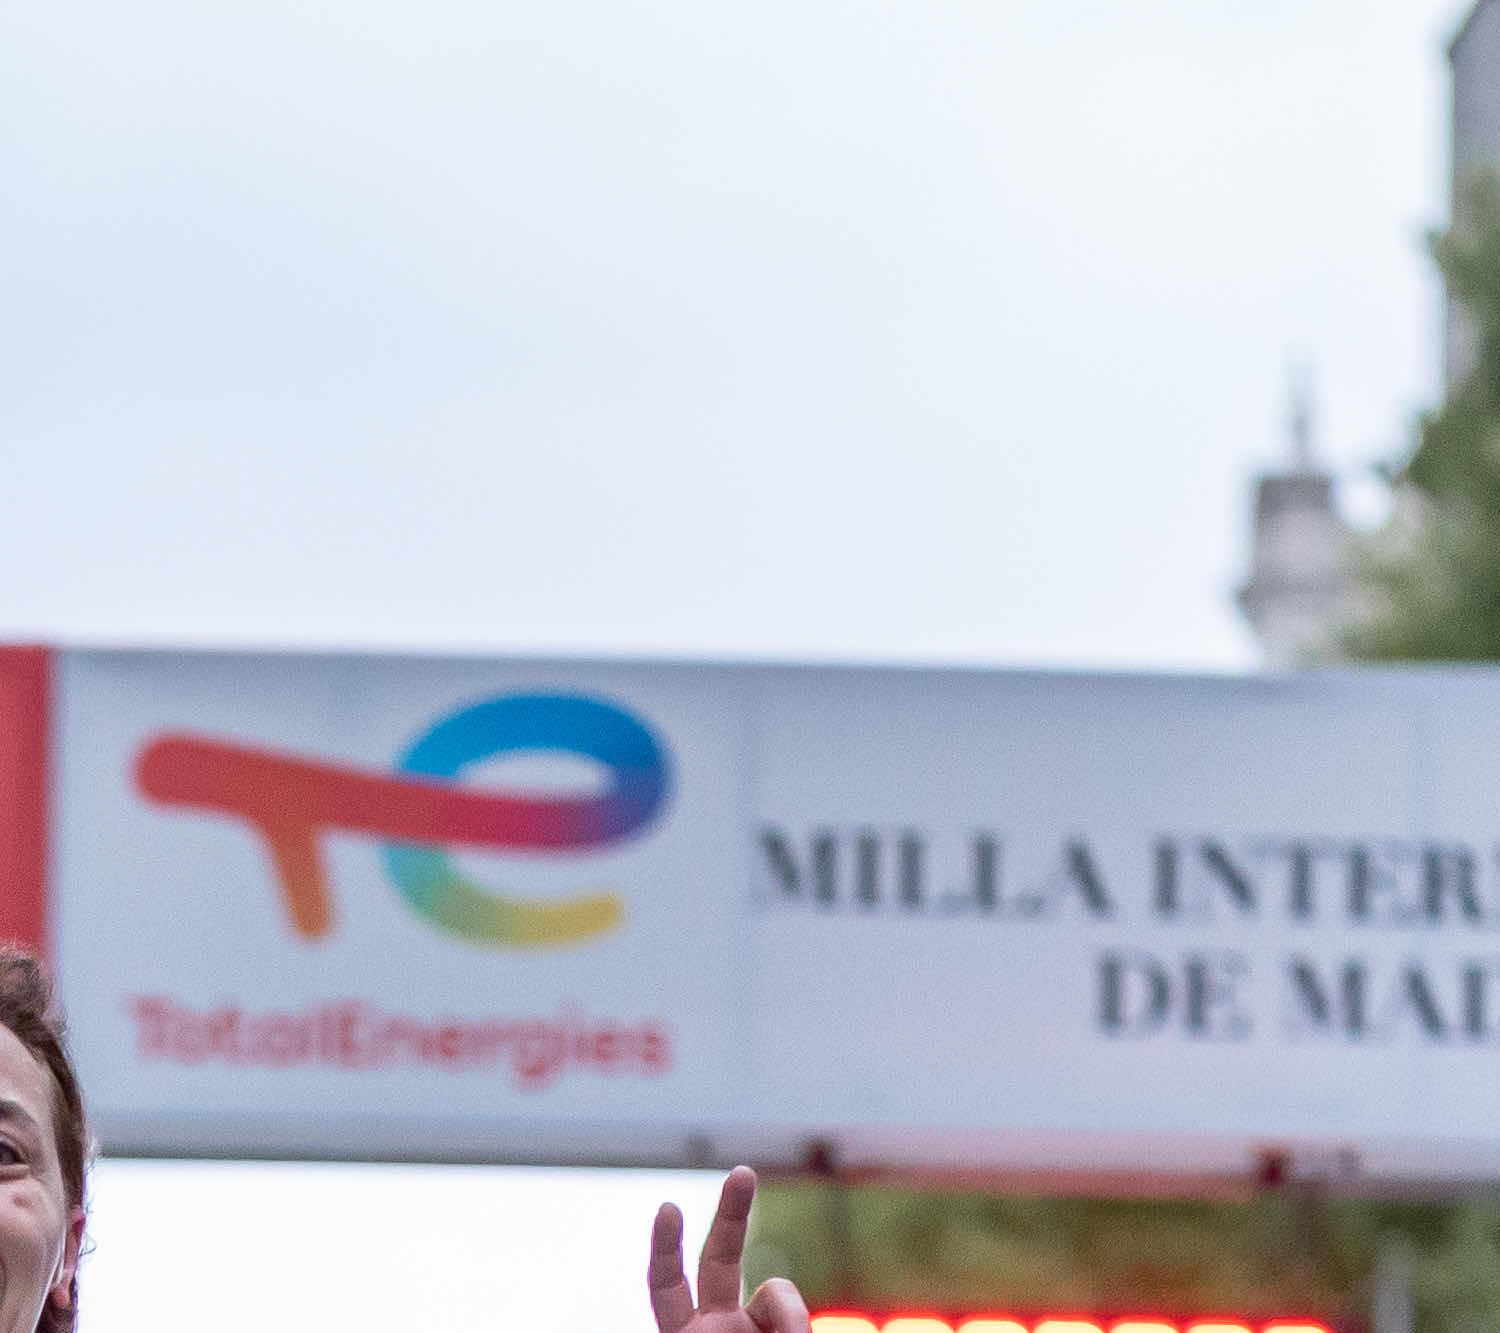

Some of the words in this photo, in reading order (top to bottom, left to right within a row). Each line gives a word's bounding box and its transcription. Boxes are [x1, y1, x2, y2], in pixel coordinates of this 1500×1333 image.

[757, 824, 1116, 920] MILLA
[130, 996, 673, 1088] TotalEnergies
[1095, 951, 1251, 1041] DE
